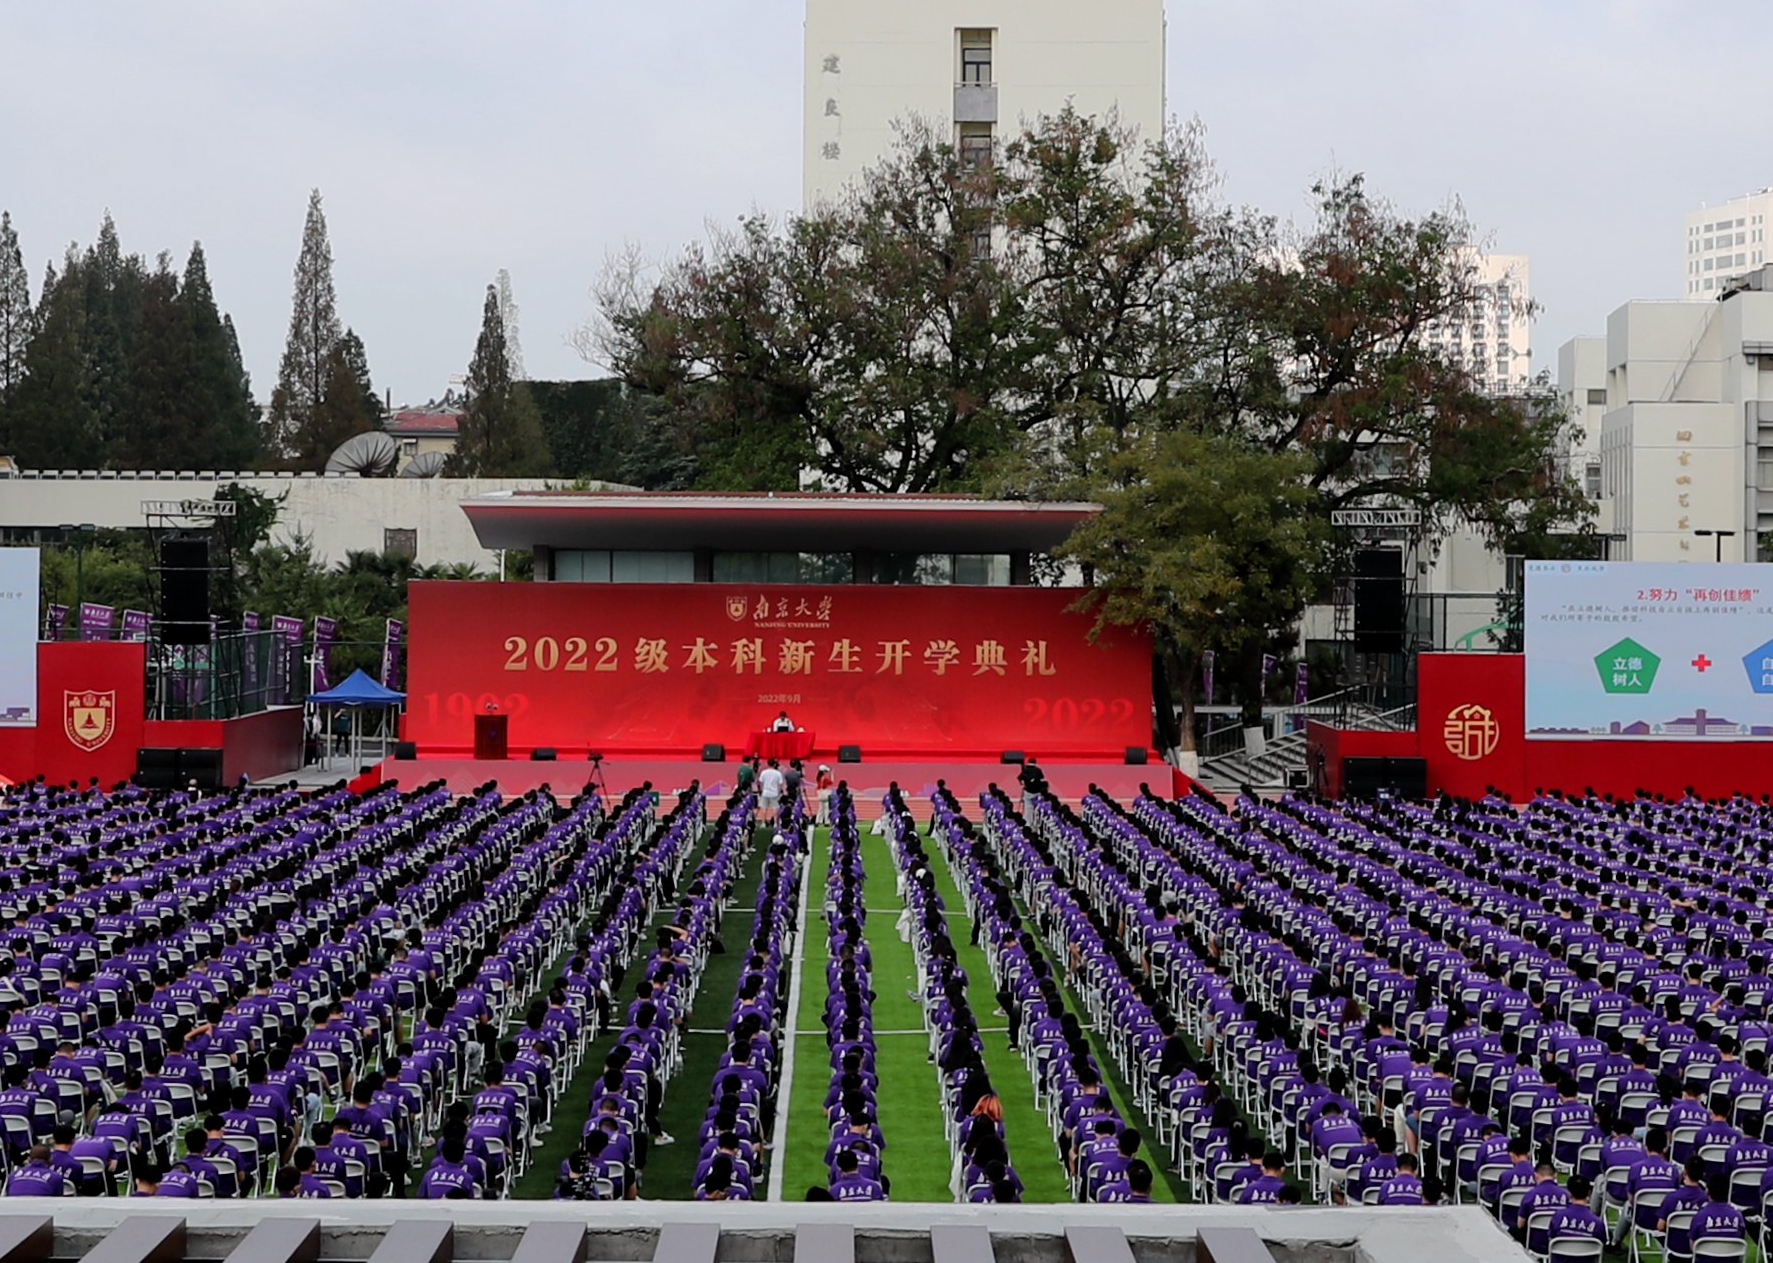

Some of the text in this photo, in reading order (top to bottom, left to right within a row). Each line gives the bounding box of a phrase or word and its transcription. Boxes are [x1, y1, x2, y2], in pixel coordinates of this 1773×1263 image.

[503, 635, 1057, 676] 2022级本科新生开学典礼
[1612, 656, 1643, 671] 立德
[1612, 672, 1643, 687] 树人
[757, 693, 801, 704] 2022年9月
[1023, 697, 1135, 732] 2022
